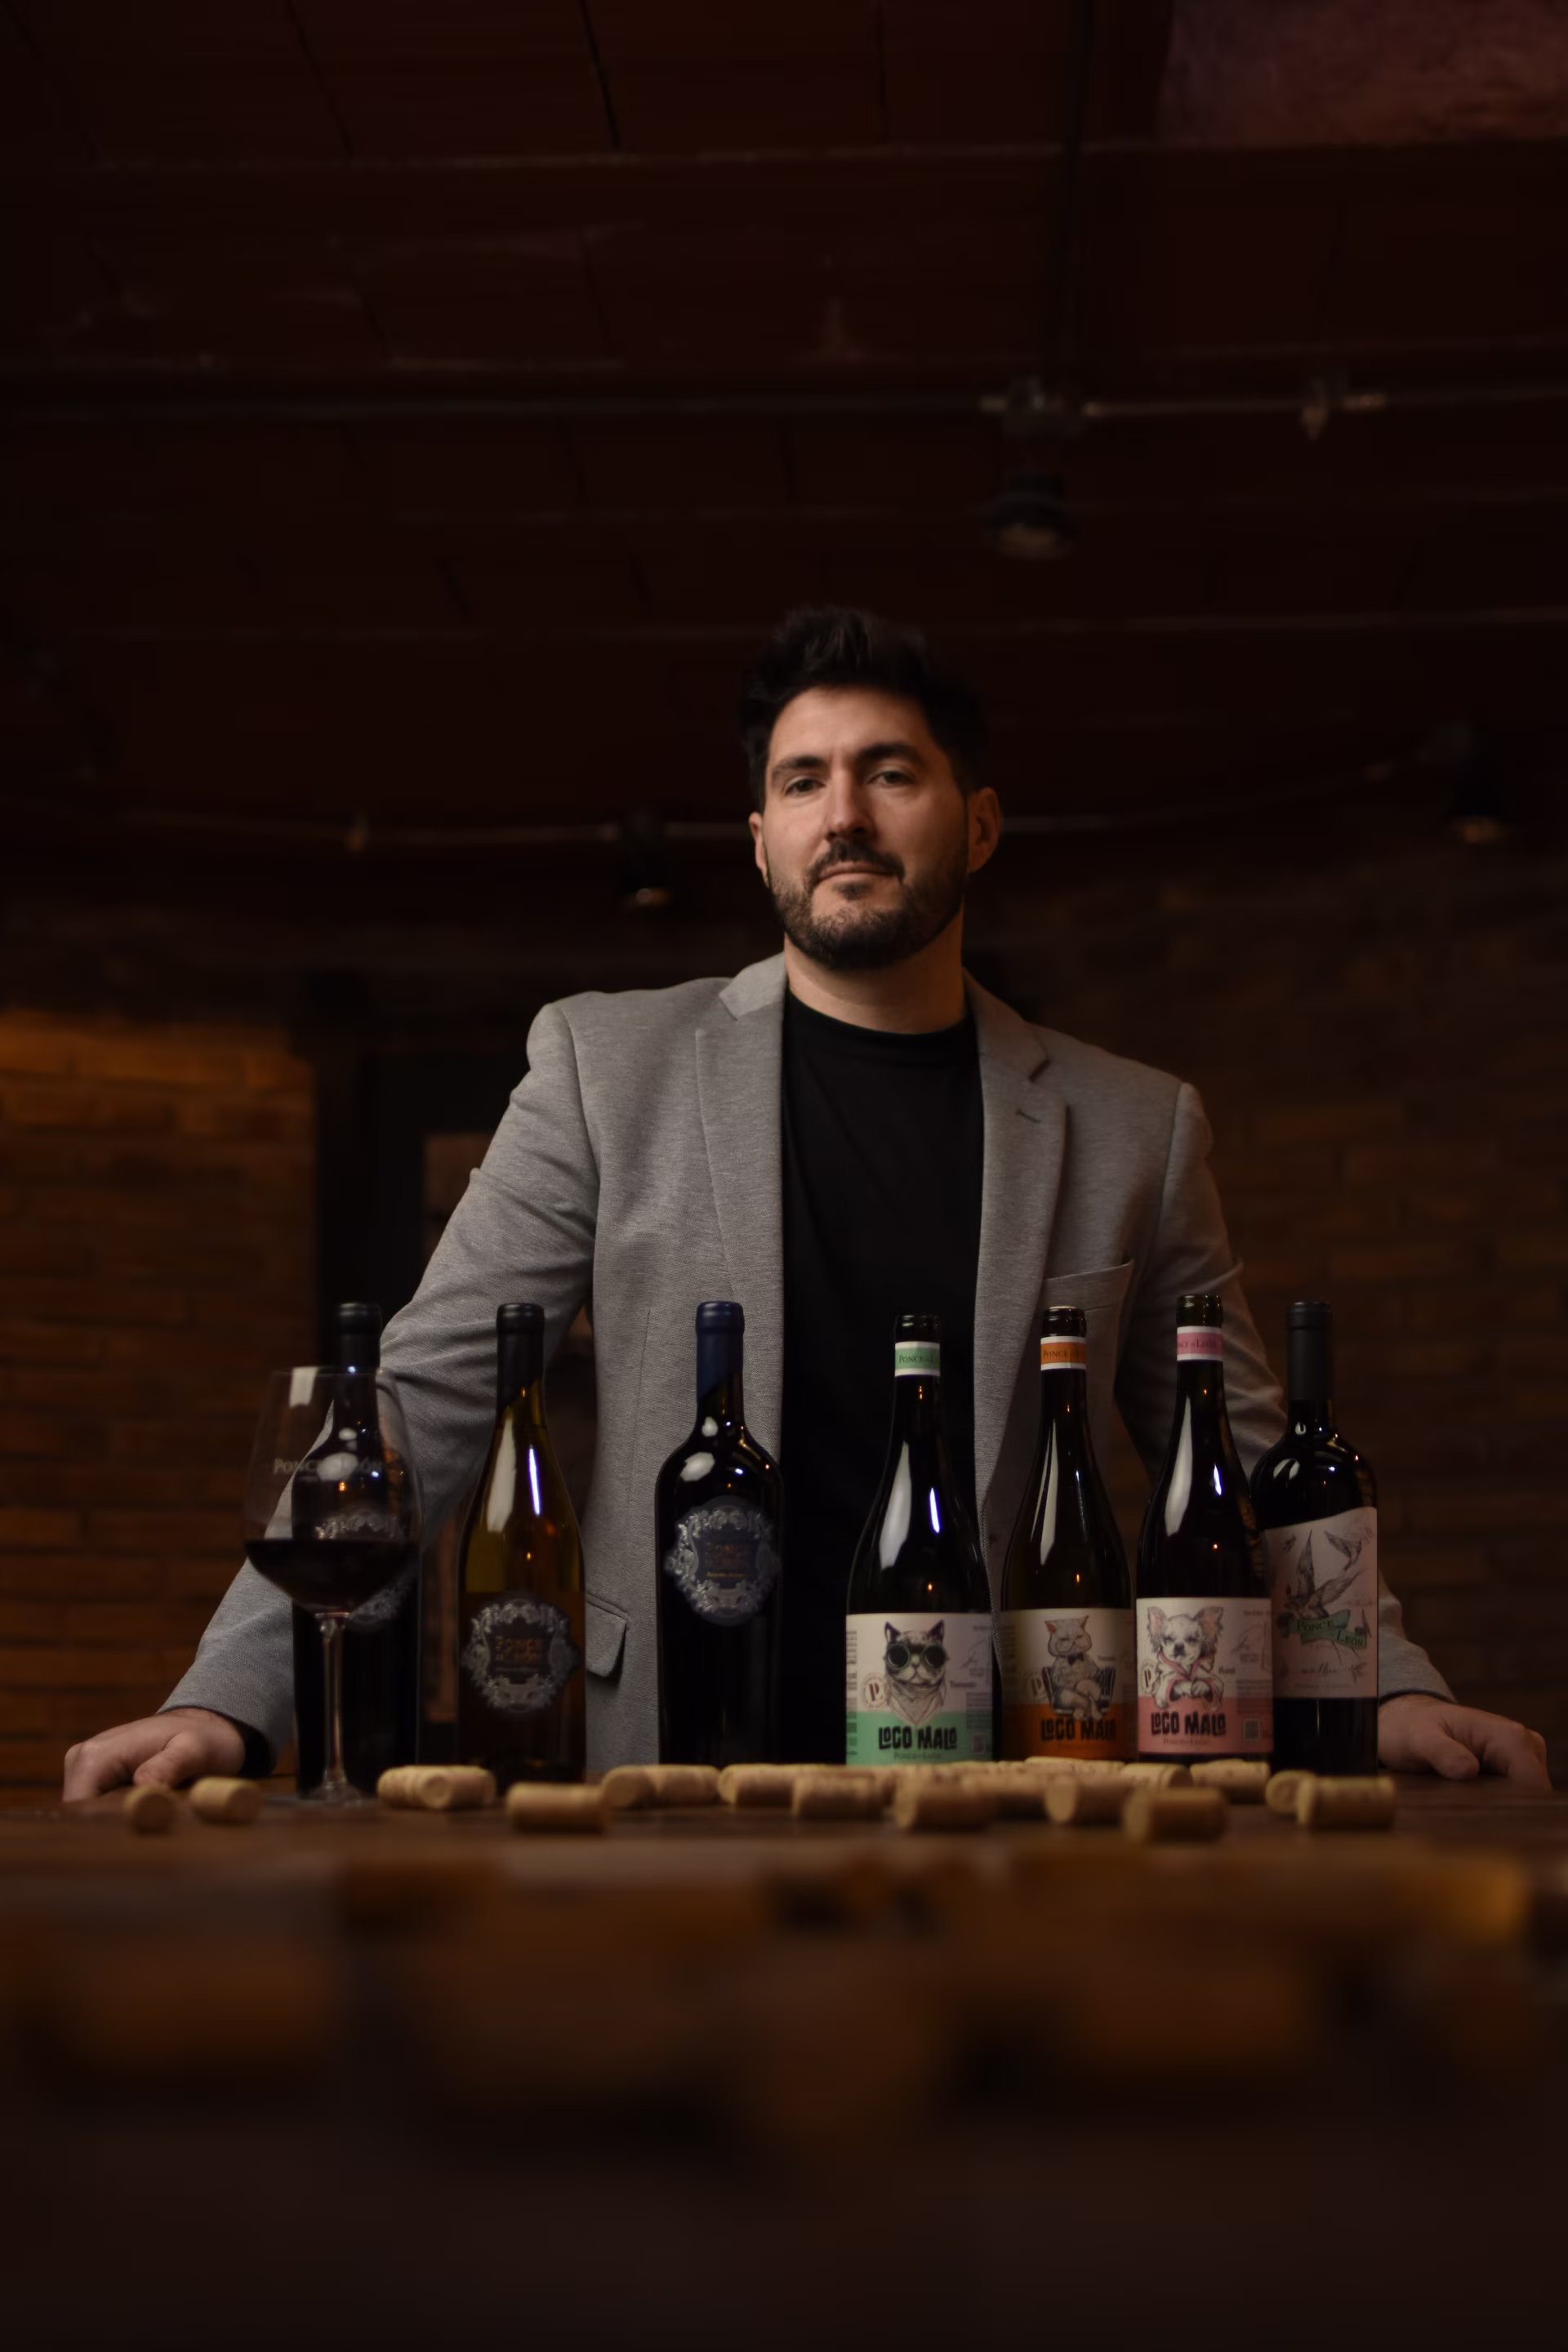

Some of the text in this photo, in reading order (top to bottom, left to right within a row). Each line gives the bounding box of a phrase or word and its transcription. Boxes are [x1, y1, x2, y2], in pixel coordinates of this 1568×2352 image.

[1296, 1619, 1335, 1632] PONCE
[1041, 1717, 1076, 1741] LOCO
[1151, 1711, 1227, 1737] LOCO MALO
[879, 1725, 957, 1750] LOCO MALO
